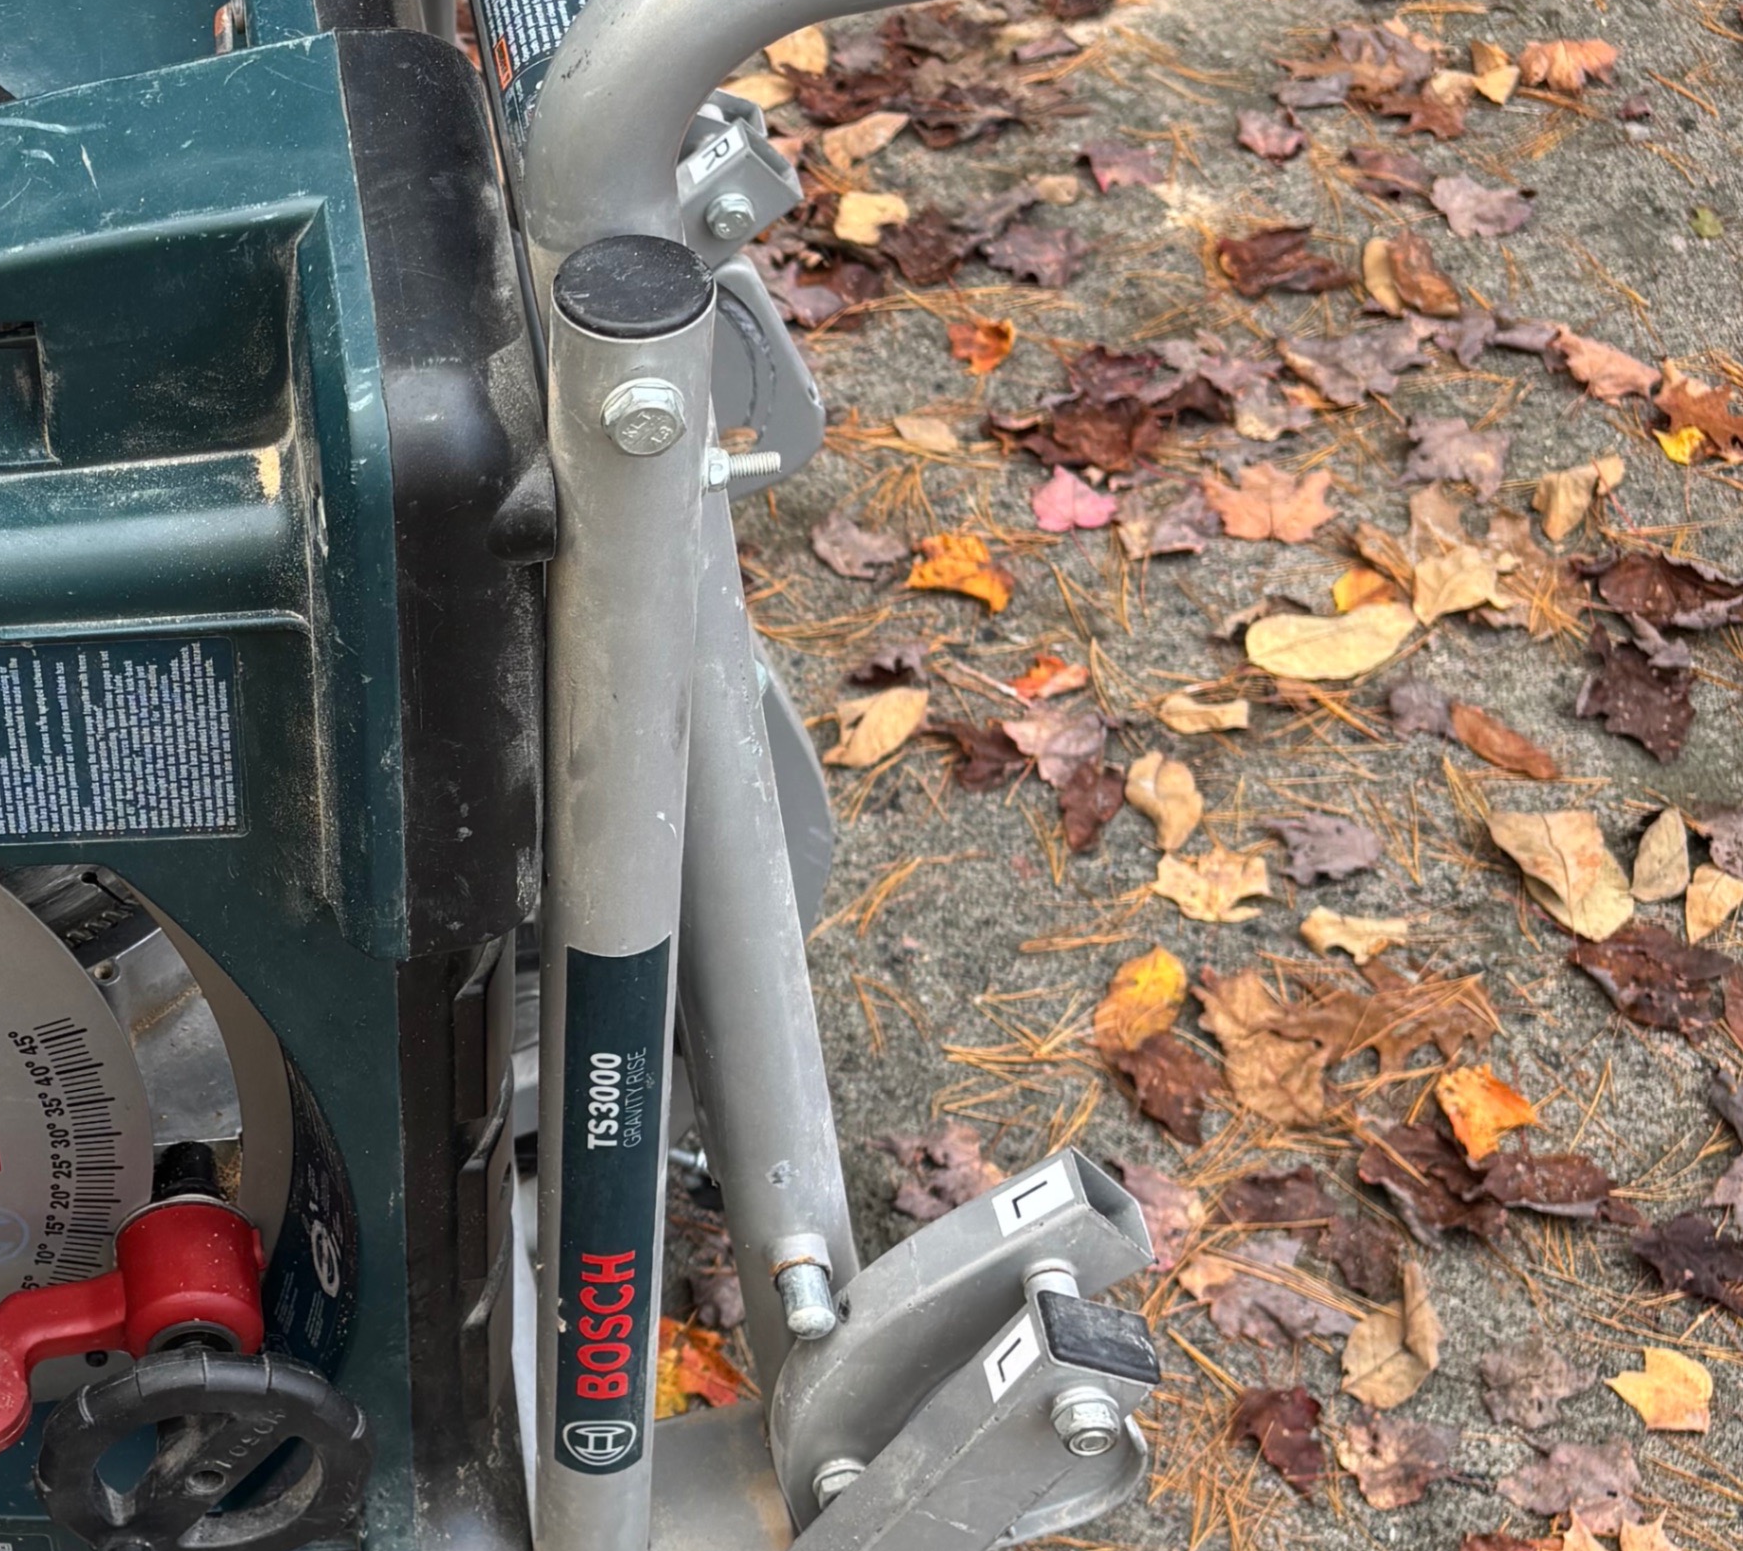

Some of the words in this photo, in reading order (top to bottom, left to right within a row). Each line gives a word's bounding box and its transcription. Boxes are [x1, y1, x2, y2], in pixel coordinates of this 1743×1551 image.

[702, 138, 729, 171] R
[9, 657, 17, 668] the
[169, 657, 179, 681] stands.
[10, 669, 19, 684] until
[12, 686, 21, 704] made
[172, 682, 182, 711] auxiliary
[15, 705, 23, 714] be
[174, 712, 183, 726] with
[16, 715, 26, 736] should
[19, 737, 31, 772] adjustment
[176, 727, 186, 763] workpieces
[23, 773, 31, 782] No
[33, 764, 44, 790] stopped.
[179, 764, 189, 778] long
[25, 785, 34, 803] blade.
[37, 791, 46, 806] been
[181, 787, 189, 802] wide
[28, 805, 38, 832] changing
[39, 807, 47, 819] has
[182, 803, 193, 827] Support
[40, 820, 49, 832] tool
[8, 1031, 39, 1056] 45°
[25, 1061, 53, 1086] 40°
[626, 1047, 647, 1085] RISE
[38, 1093, 64, 1117] 35°
[587, 1052, 622, 1150] TS3000
[623, 1086, 644, 1148] GRAVITY
[47, 1123, 70, 1148] 30°
[51, 1153, 72, 1179] 25°
[50, 1184, 70, 1209] 20°
[1012, 1181, 1047, 1218] L
[45, 1215, 65, 1237] 15°
[34, 1243, 55, 1265] 10°
[575, 1250, 636, 1400] BOSCH
[997, 1338, 1021, 1382] L
